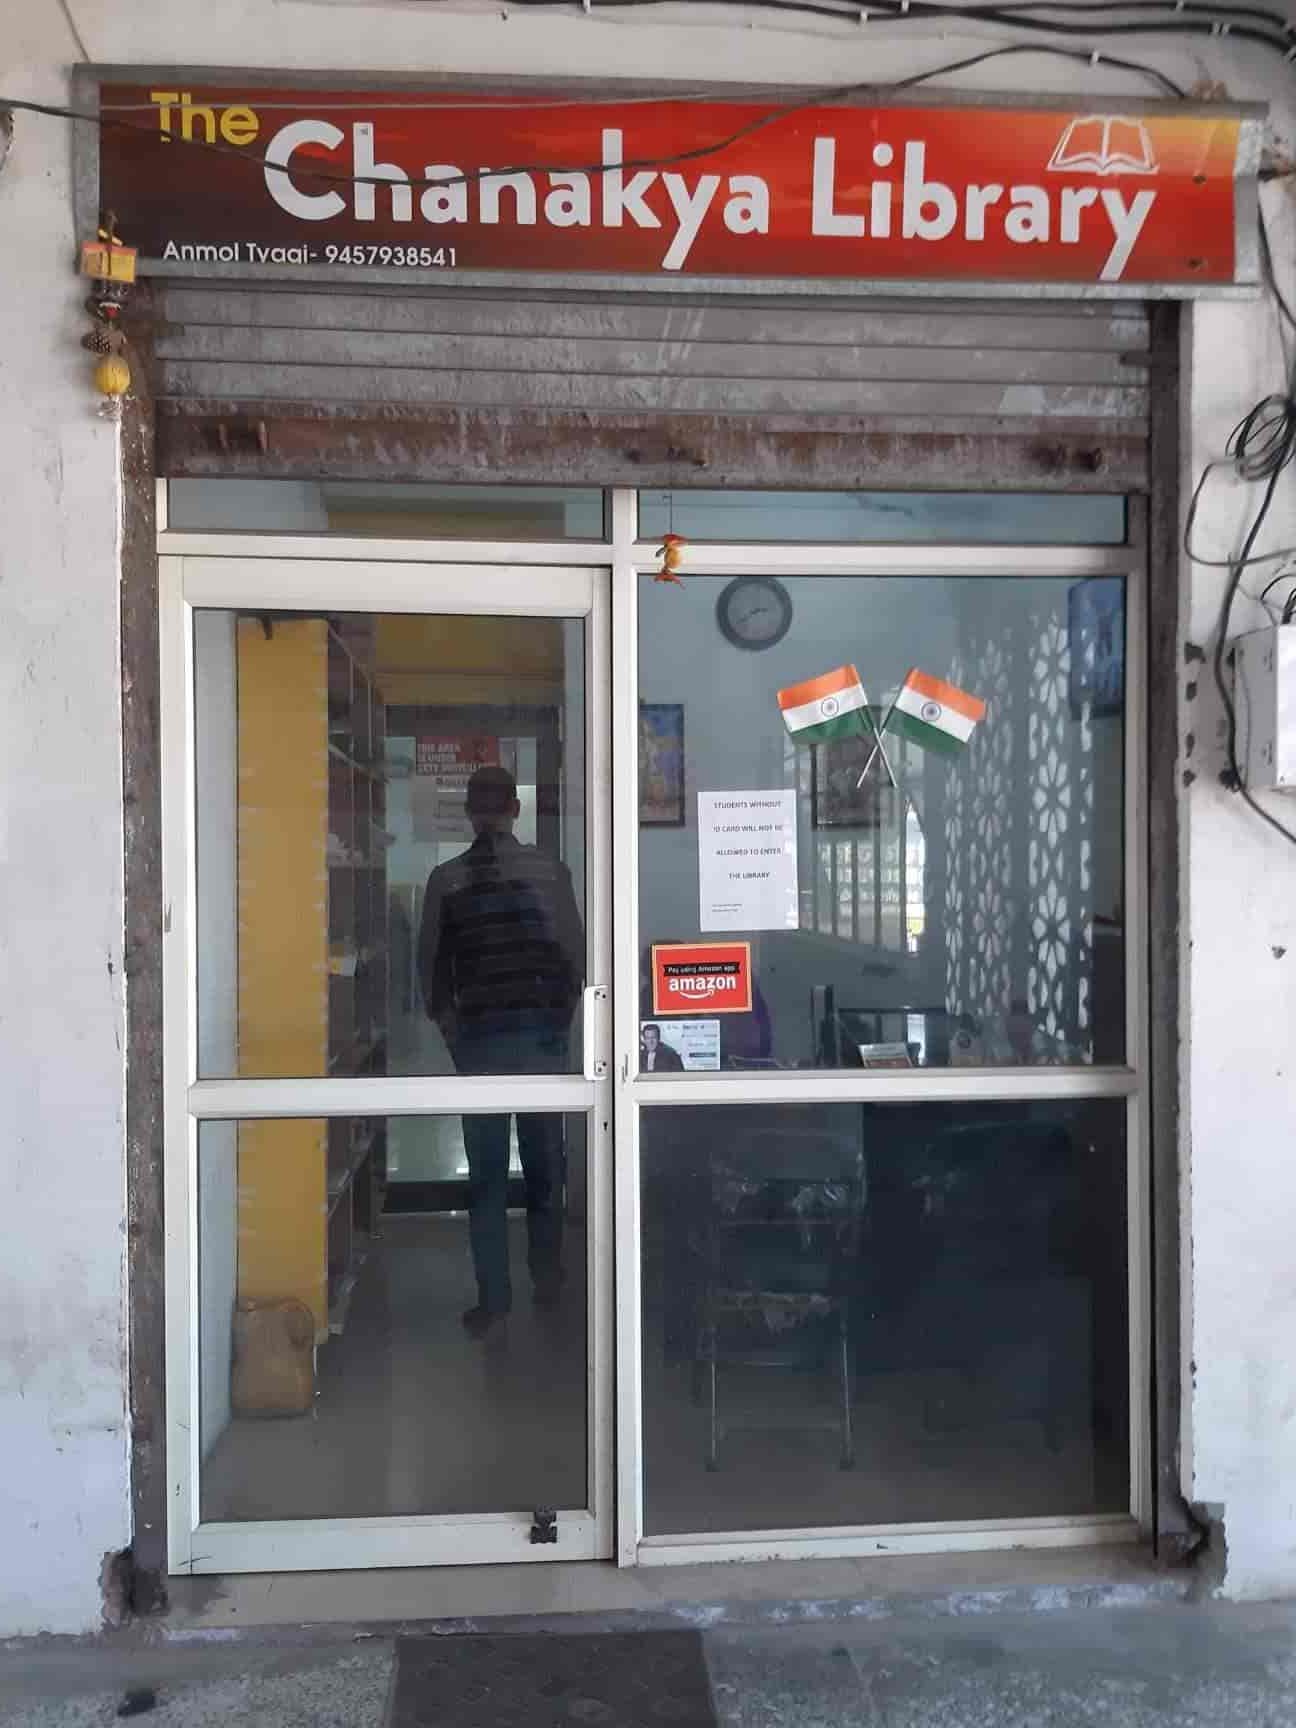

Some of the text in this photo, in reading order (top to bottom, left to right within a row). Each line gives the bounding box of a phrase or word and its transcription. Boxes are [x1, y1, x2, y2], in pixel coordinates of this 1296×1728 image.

[151, 92, 1157, 281] The Chanakya Library
[162, 240, 239, 263] Anmol
[325, 245, 457, 267] 9457938541
[713, 800, 782, 809] STUDENTS WITHOUT
[722, 824, 740, 832] CARD
[741, 824, 758, 832] WILL
[759, 823, 773, 832] NOT
[715, 847, 748, 856] ALLOWED
[760, 847, 781, 856] ENTER
[729, 871, 771, 880] THE LIBRARY
[668, 975, 737, 992] amazon
